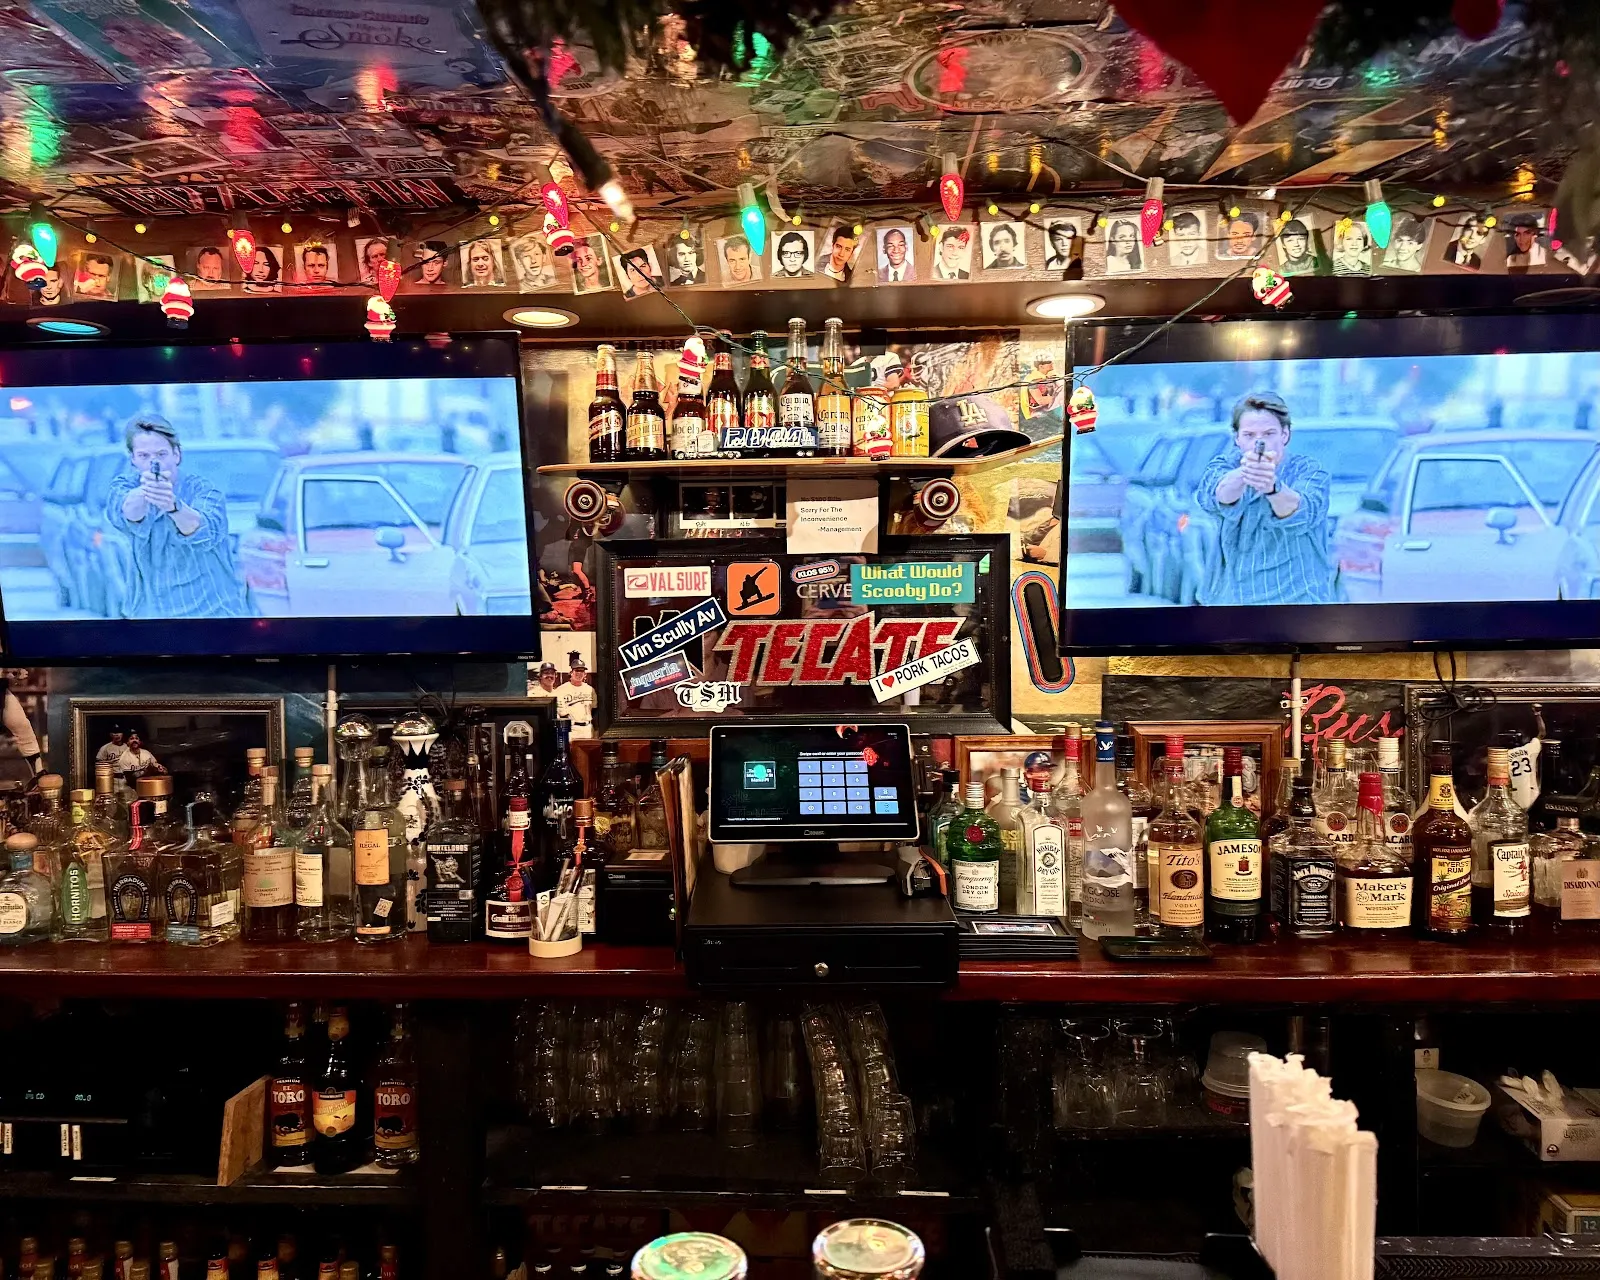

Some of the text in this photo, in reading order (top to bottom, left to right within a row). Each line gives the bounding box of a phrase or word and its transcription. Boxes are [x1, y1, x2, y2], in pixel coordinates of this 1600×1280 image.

[299, 22, 432, 50] Smoke
[797, 568, 818, 579] KLOS
[861, 564, 963, 580] What Would
[650, 571, 708, 592] VAL SURF
[861, 582, 963, 601] Scooby Do?
[625, 606, 716, 662] Vin Scully Av
[712, 610, 968, 687] TECATE
[894, 661, 929, 685] PORK
[928, 643, 970, 670] TACOS
[1511, 757, 1532, 777] 23
[1036, 844, 1061, 854] BOMBAY
[1166, 853, 1202, 866] Tito's
[1049, 865, 1061, 875] GIN
[113, 877, 149, 892] HERRADURA
[167, 878, 196, 894] HERRADURA
[1355, 882, 1407, 891] Maker's
[70, 868, 81, 922] HORNITOS
[1369, 892, 1406, 902] Mark
[272, 1090, 306, 1104] TORO
[377, 1092, 411, 1106] TORO
